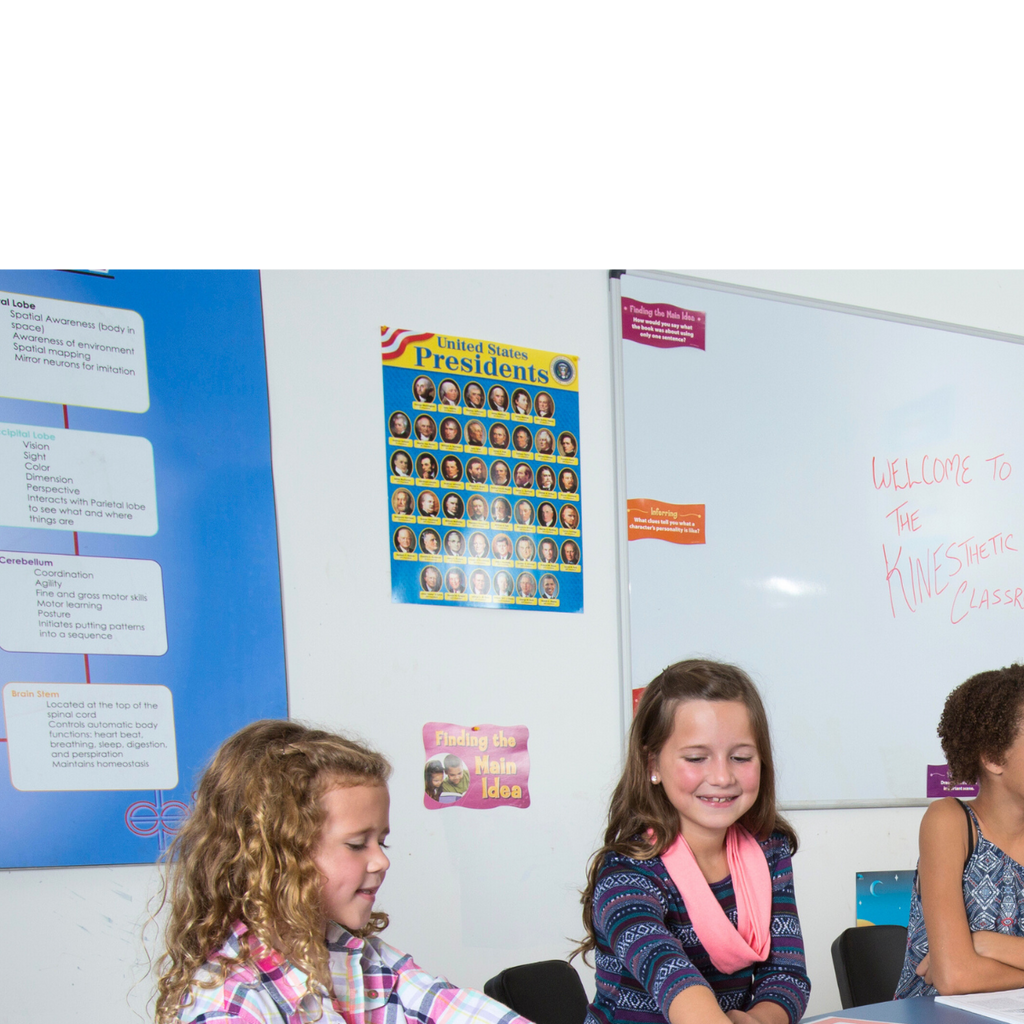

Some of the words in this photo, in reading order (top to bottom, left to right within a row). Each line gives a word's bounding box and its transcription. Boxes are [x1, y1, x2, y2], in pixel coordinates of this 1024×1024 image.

[12, 300, 36, 310] Lobe
[10, 310, 43, 322] Spatial
[46, 316, 96, 329] Awareness
[98, 322, 125, 334] (body
[127, 326, 136, 334] in
[12, 322, 44, 334] space)
[12, 332, 64, 346] Awareness
[78, 342, 135, 354] environment
[436, 336, 484, 354] United
[488, 342, 528, 360] States
[13, 342, 46, 354] Spatial
[48, 348, 90, 361] mapping
[14, 354, 41, 364] Mirror
[44, 358, 80, 369] neurons
[82, 360, 94, 370] for
[96, 364, 136, 376] imitation
[414, 346, 550, 384] Presidents
[32, 431, 56, 440] Lobe
[22, 440, 50, 450] Vision
[24, 452, 46, 462] Sight
[24, 462, 50, 471] Color
[872, 454, 973, 491] WELCOME
[985, 453, 1012, 481] TO
[26, 472, 74, 484] Dimension
[26, 483, 80, 495] Perspective
[27, 494, 68, 504] Interacts
[70, 498, 88, 506] with
[90, 498, 124, 509] Parietal
[126, 502, 146, 510] lobe
[28, 504, 38, 512] to
[40, 506, 57, 514] see
[59, 506, 82, 516] what
[85, 508, 103, 518] and
[105, 510, 133, 520] where
[886, 500, 922, 536] THE
[30, 515, 56, 526] things
[0, 556, 53, 566] Cerebellum
[34, 569, 94, 579] Coordination
[882, 532, 1018, 619] KINESTHETIC
[35, 580, 62, 589] Agility
[66, 600, 102, 611] learning
[38, 610, 71, 618] Posture
[39, 620, 73, 628] Initiates
[75, 622, 107, 631] putting
[109, 623, 145, 631] patterns
[68, 632, 112, 640] sequence
[435, 729, 488, 752] Finding
[492, 730, 516, 748] the
[72, 751, 123, 759] perspiration
[475, 755, 517, 775] Main
[482, 777, 522, 798] Idea
